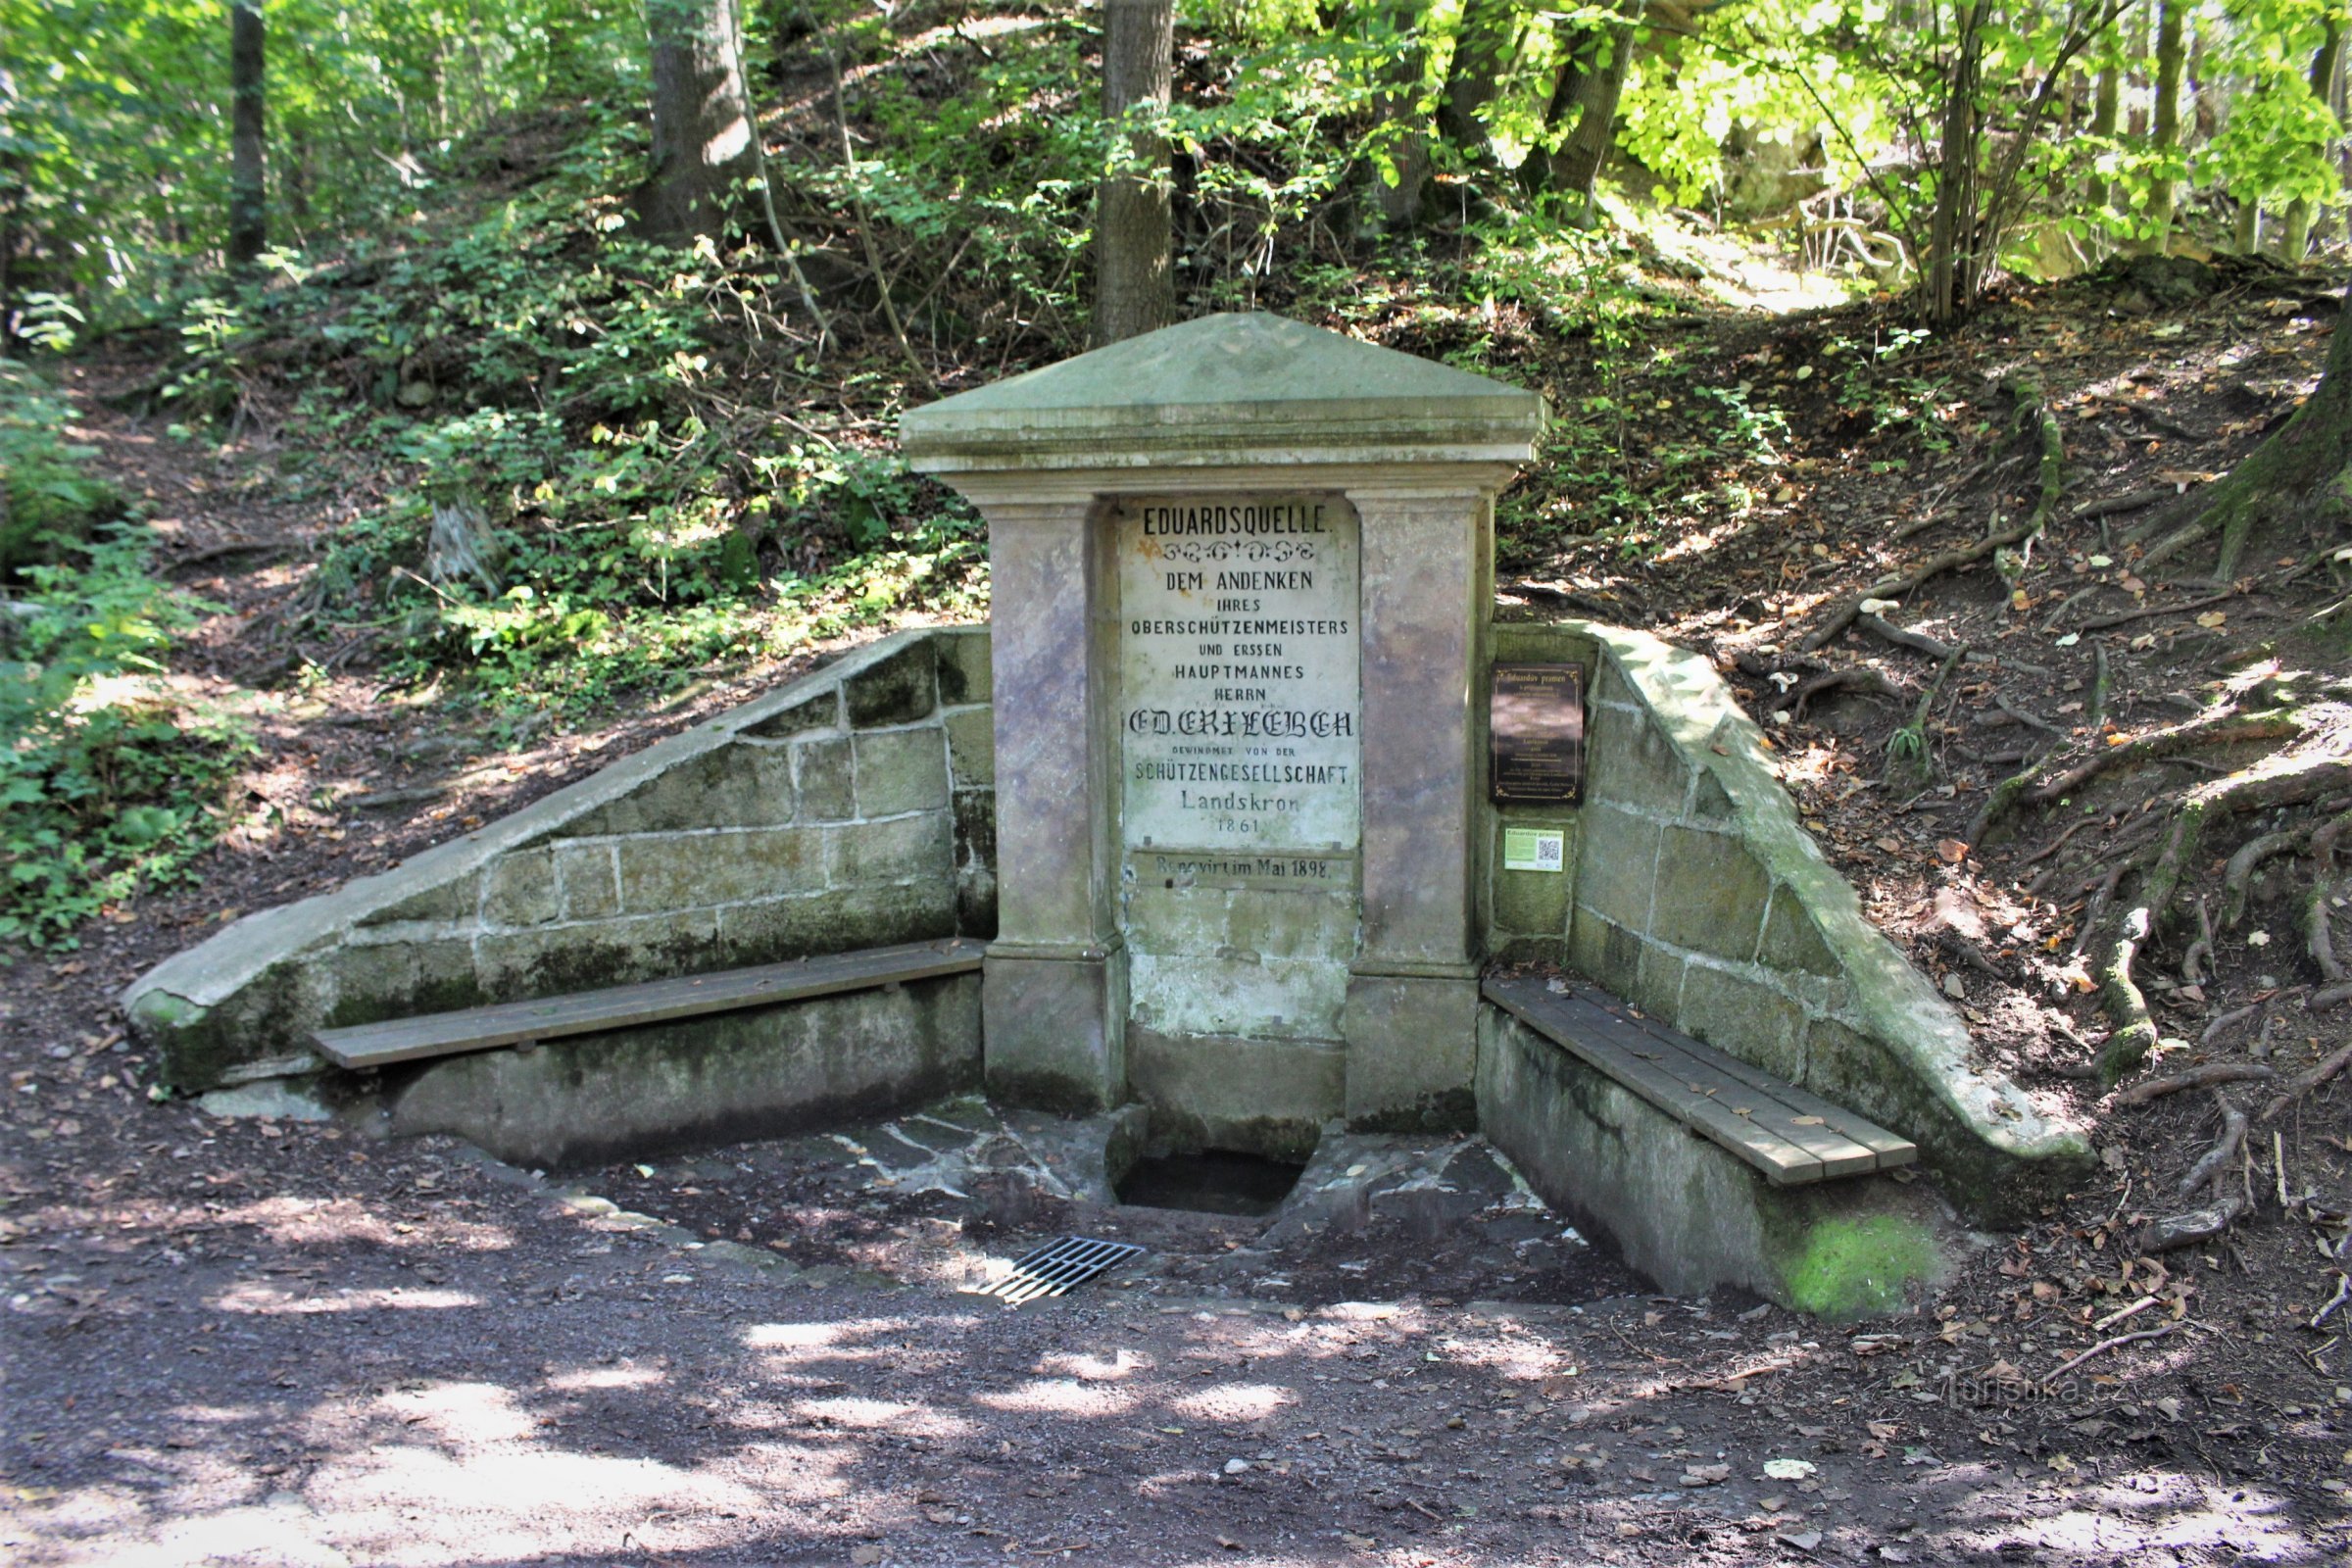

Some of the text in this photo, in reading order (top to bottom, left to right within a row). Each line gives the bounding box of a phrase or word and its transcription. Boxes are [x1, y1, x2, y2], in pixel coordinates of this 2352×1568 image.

[1144, 505, 1333, 536] EDUARDSQUELLE.
[1166, 570, 1313, 591] DEM ANDENKEN
[1217, 599, 1260, 612] IHRES
[1131, 615, 1348, 635] OBERSCHÜTZENMEISTERS
[1199, 644, 1223, 657] UND
[1175, 664, 1304, 680] HAUPTMANNES
[1214, 688, 1266, 702] HERRN
[1246, 748, 1268, 757] VON
[1276, 748, 1296, 758] DER
[1136, 760, 1348, 785] SCHÜTZENGESELLSCHAFT
[1181, 790, 1300, 812] Landskron
[1218, 818, 1259, 833] 1861
[1232, 859, 1251, 874] im
[1257, 858, 1285, 877] Mai
